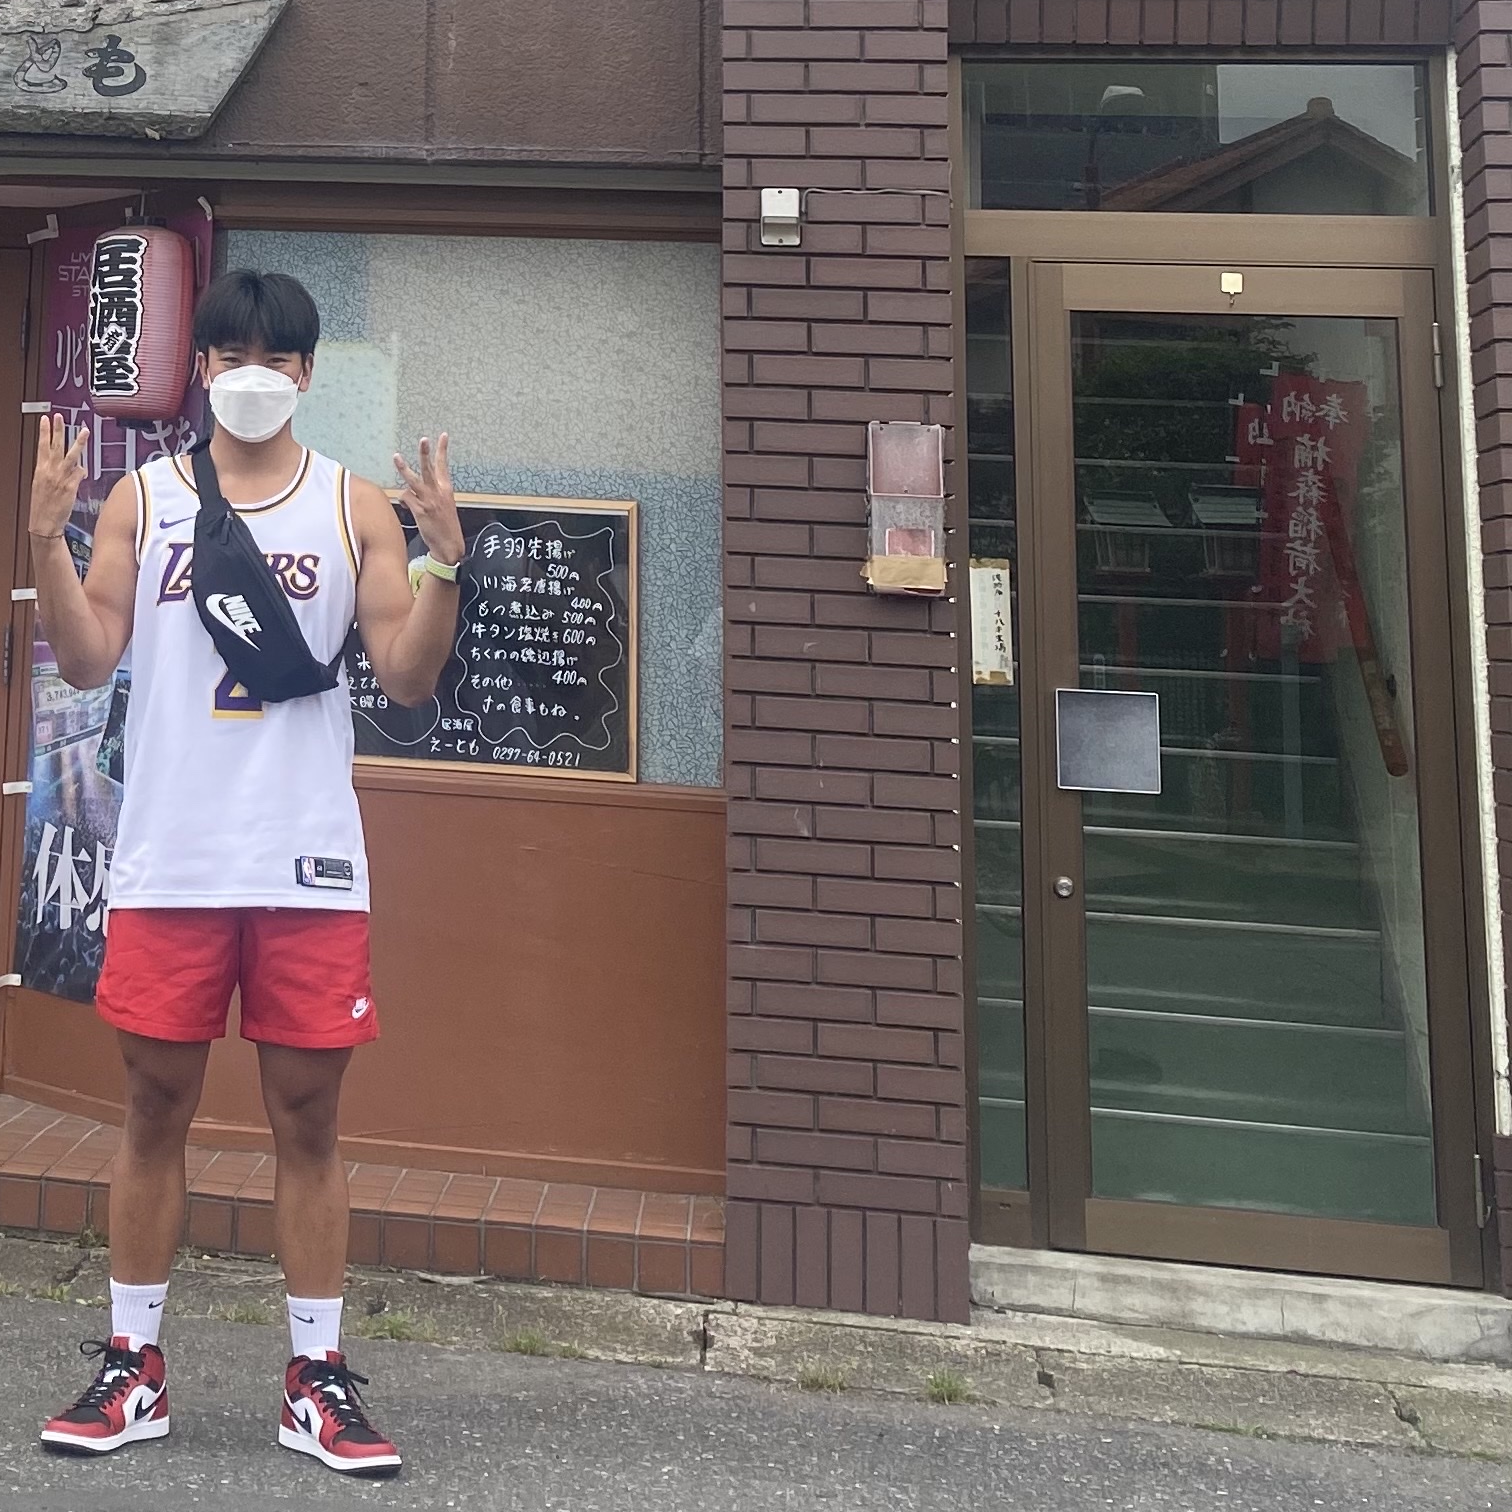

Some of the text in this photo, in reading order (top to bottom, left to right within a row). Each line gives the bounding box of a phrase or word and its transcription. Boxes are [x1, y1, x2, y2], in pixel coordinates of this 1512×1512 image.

[70, 252, 92, 263] LIV
[89, 236, 146, 396] 居酒屋
[482, 535, 576, 561] 手羽先揚げ
[545, 563, 580, 582] 500円
[477, 600, 555, 621] もつ煮込み
[570, 597, 603, 612] 400円
[222, 594, 263, 636] NIKE
[561, 610, 596, 626] 500円
[471, 624, 559, 643] 牛タン塩焼き
[562, 628, 596, 646] 600円
[470, 646, 578, 667] ちくわの磯辺揚げ
[552, 670, 588, 686] 400円
[441, 717, 474, 731] 居酒屋
[430, 737, 479, 756] えーとも
